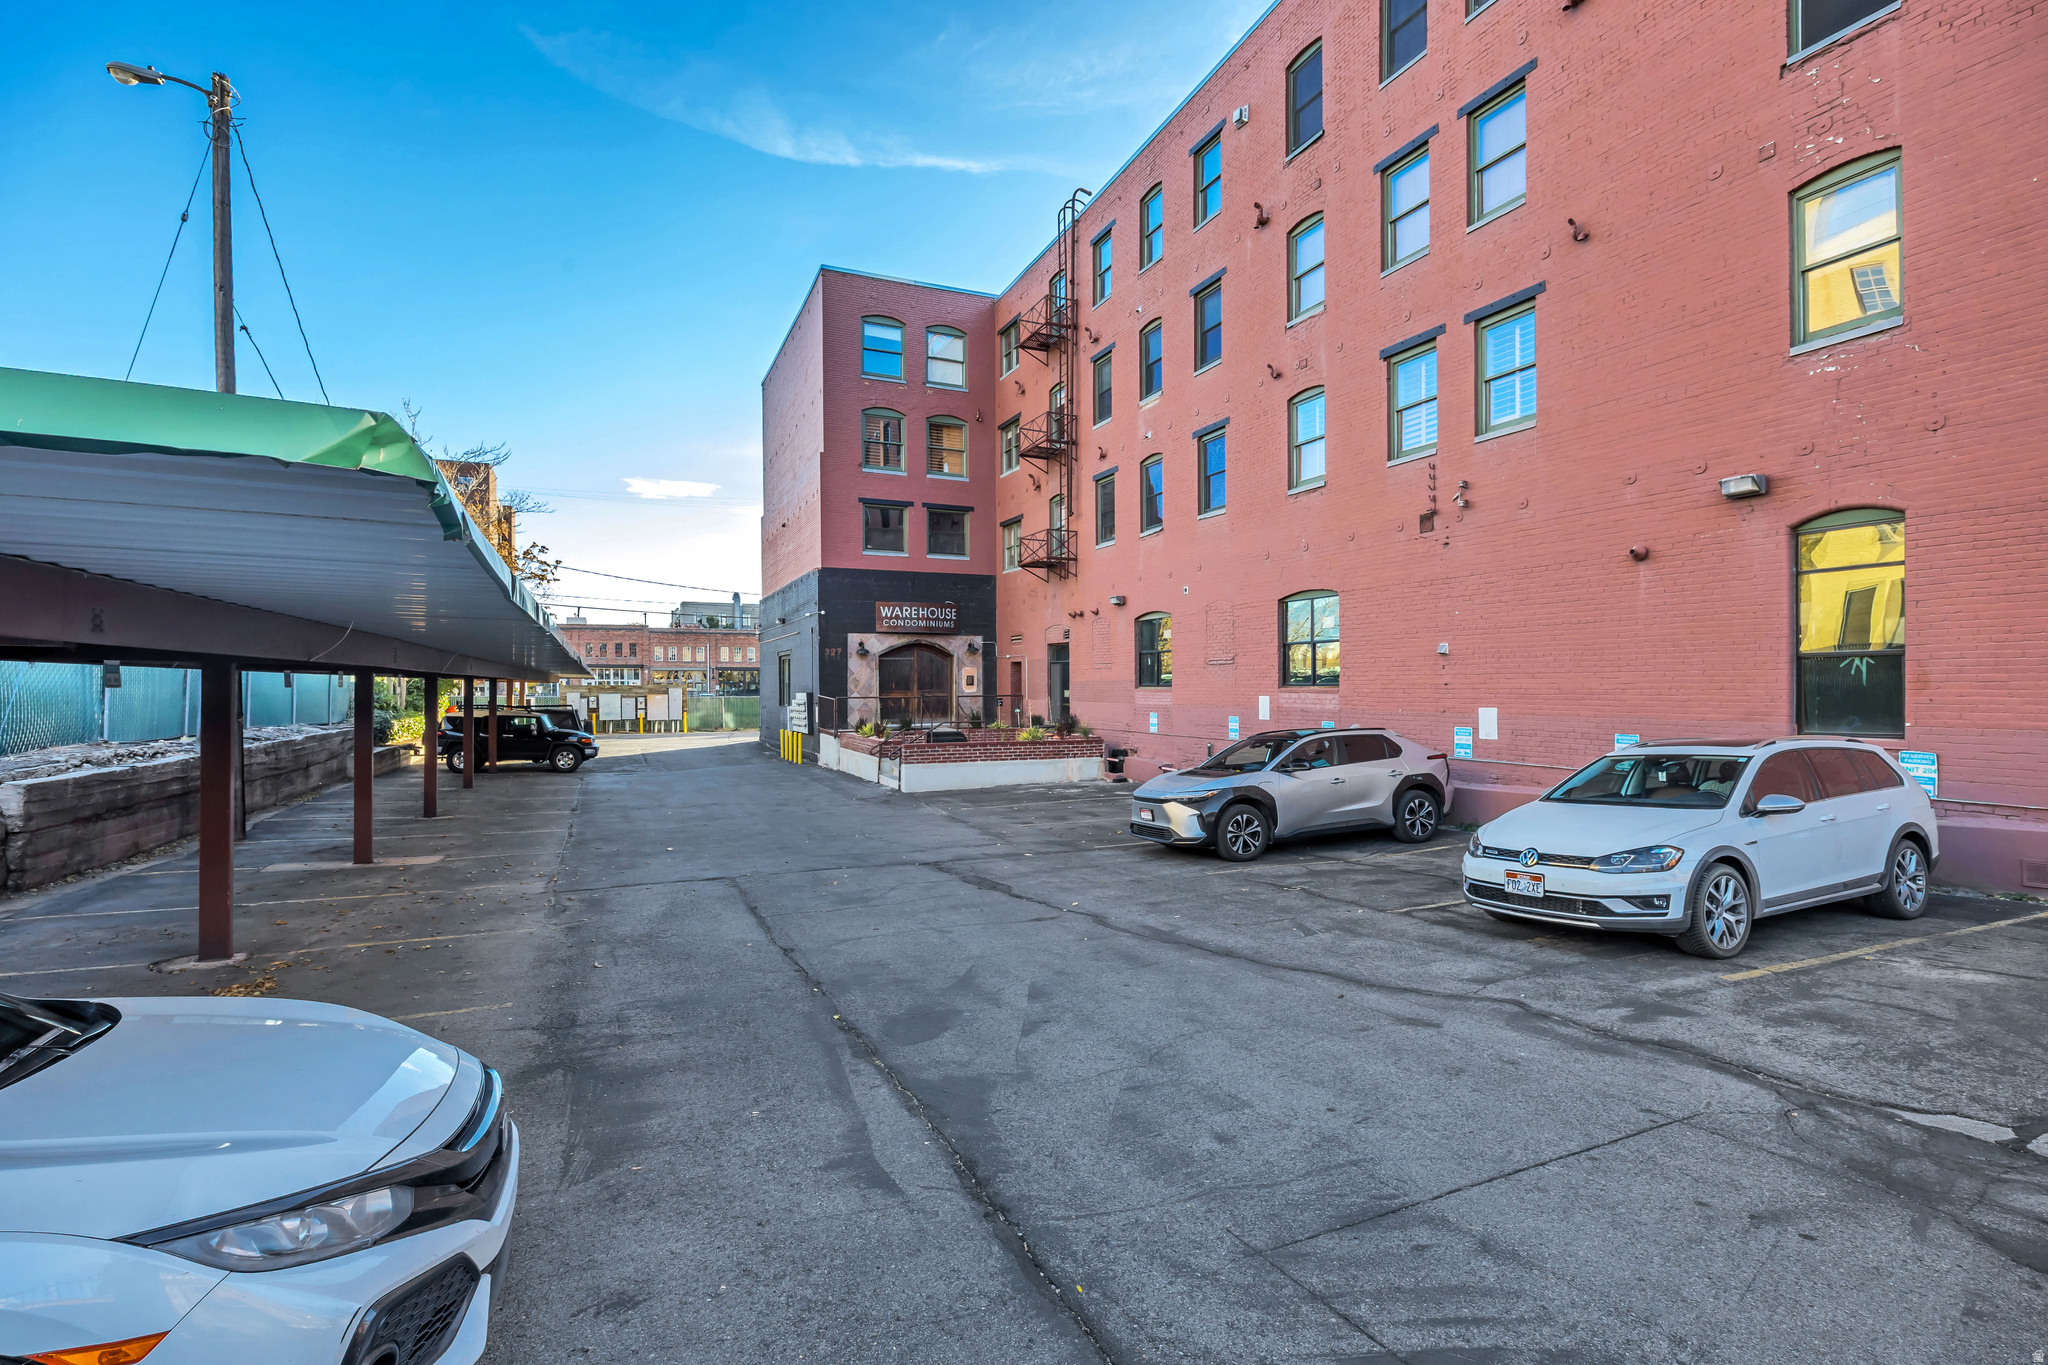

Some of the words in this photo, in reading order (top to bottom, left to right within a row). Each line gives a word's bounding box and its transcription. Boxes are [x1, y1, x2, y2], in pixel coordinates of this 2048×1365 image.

[880, 606, 957, 619] WAREHOUSE
[883, 619, 954, 628] CONDOMINIUMS
[825, 648, 842, 656] 327
